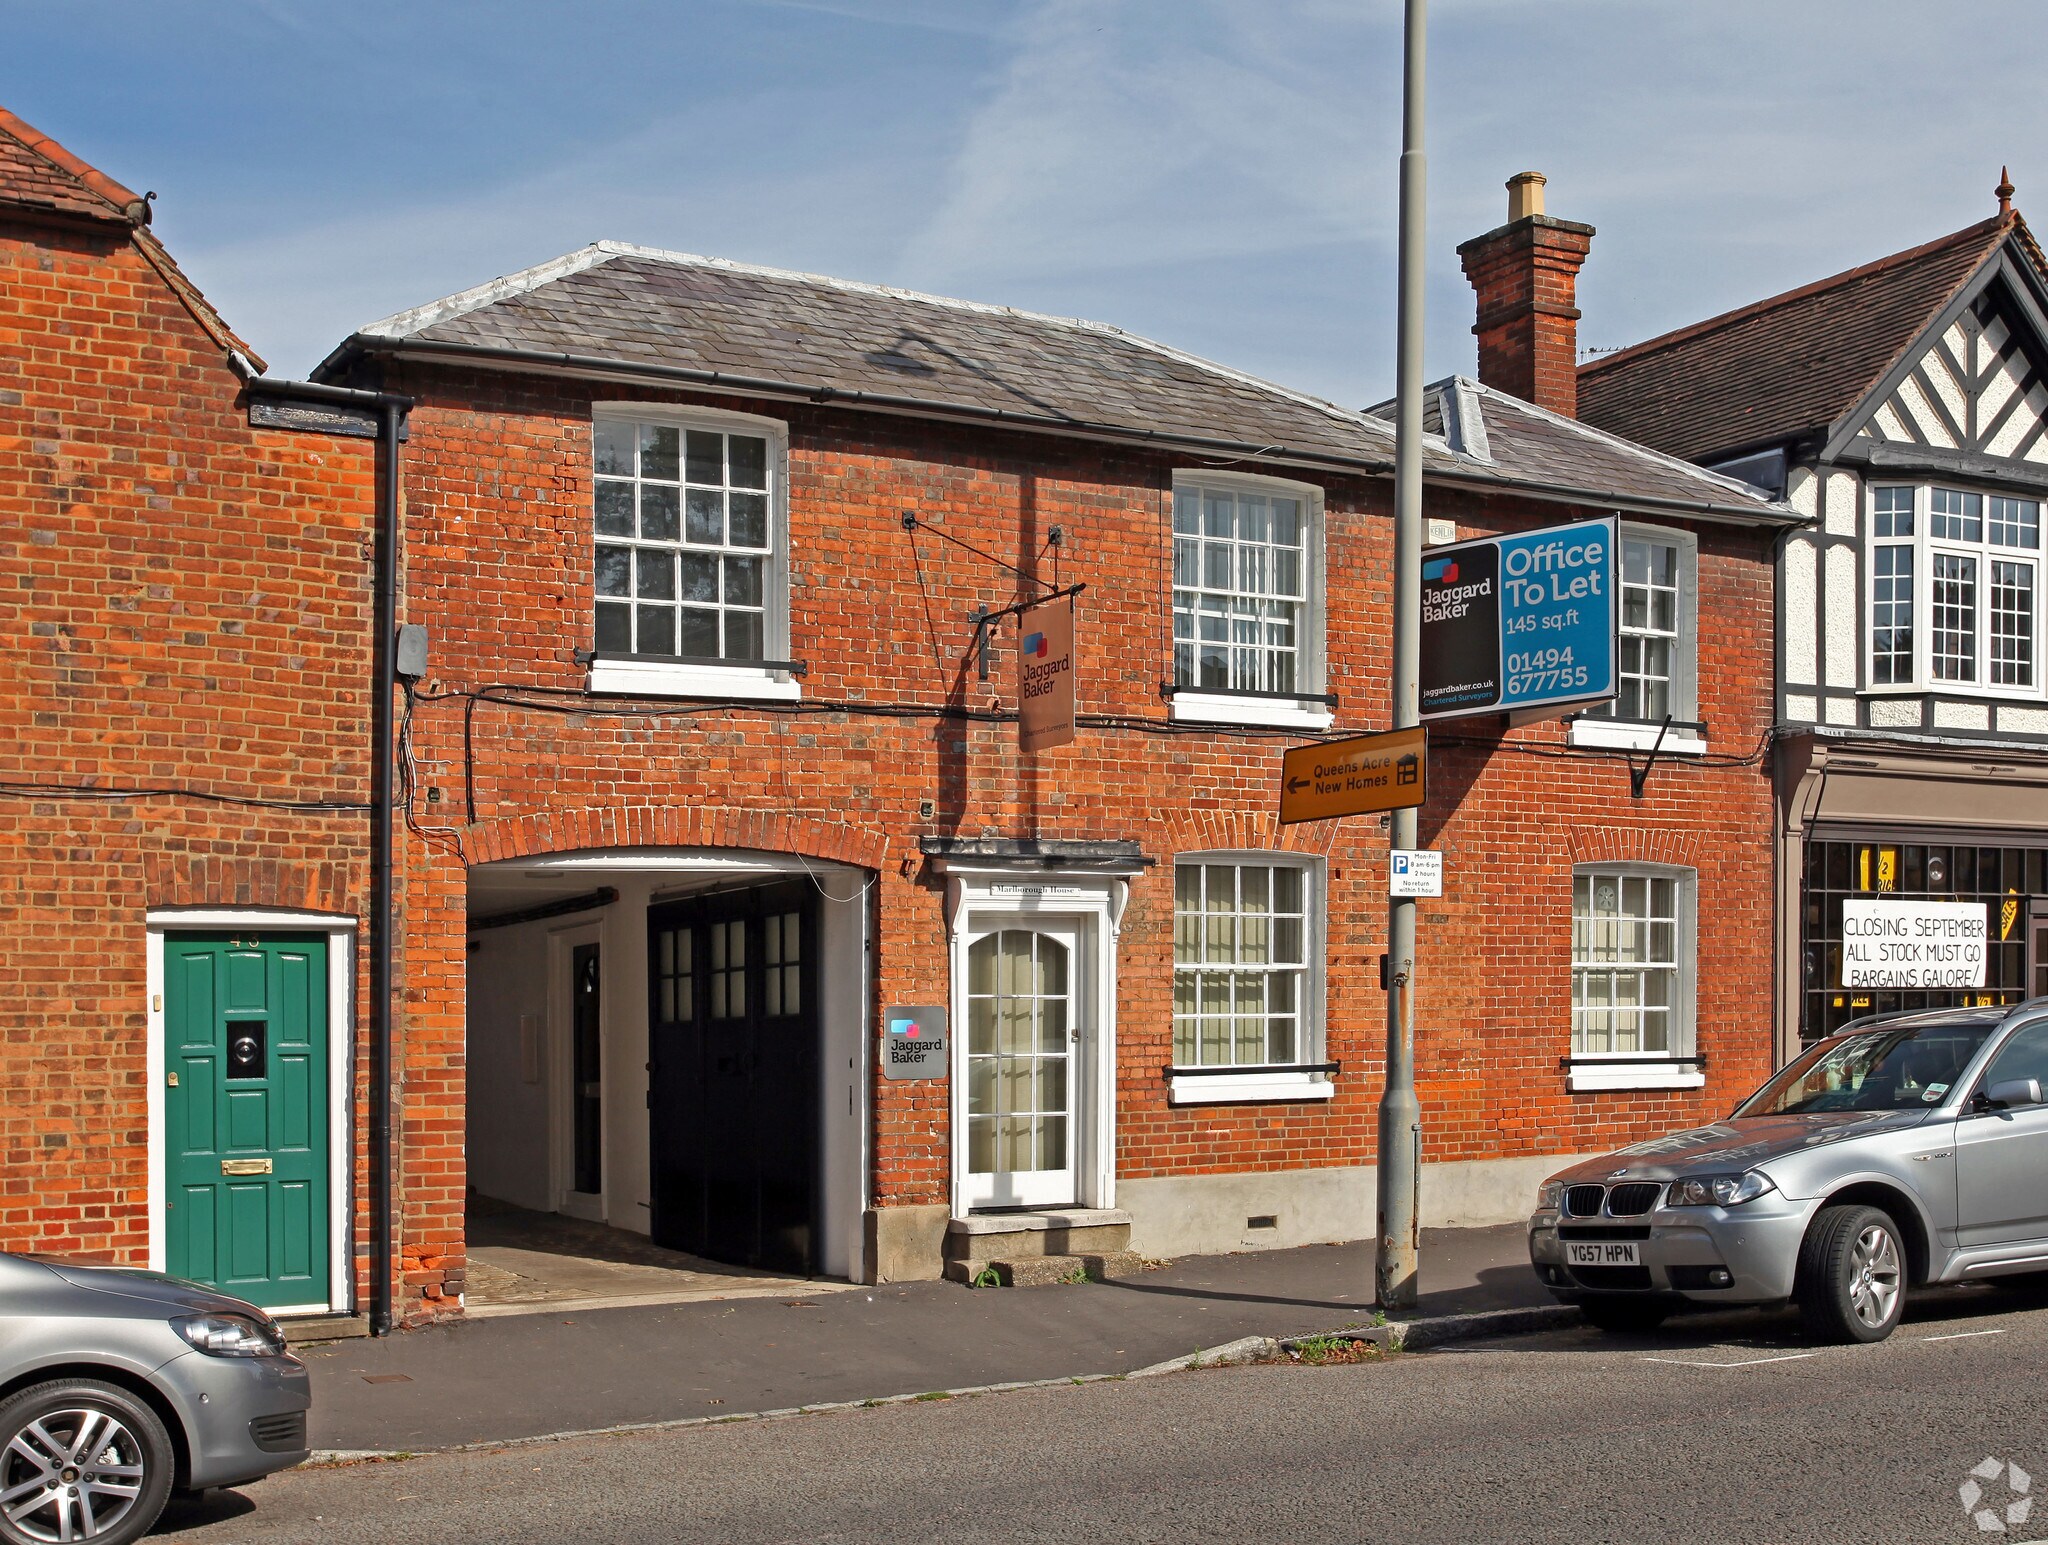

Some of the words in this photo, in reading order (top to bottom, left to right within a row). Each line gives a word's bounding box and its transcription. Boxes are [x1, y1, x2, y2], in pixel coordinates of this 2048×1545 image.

[1505, 541, 1603, 576] Office
[1423, 579, 1491, 606] Jaggard
[1505, 579, 1545, 608] To
[1550, 570, 1601, 601] Let
[1423, 602, 1469, 622] Baker
[1506, 615, 1536, 634] 145
[1542, 609, 1579, 631] sq.ft
[1023, 654, 1069, 682] Jaggard
[1508, 646, 1573, 673] 01494
[1024, 680, 1055, 699] Baker
[1423, 680, 1494, 698] jaggardbaker.co.uk
[1508, 666, 1588, 694] 677755
[1424, 694, 1457, 706] Chartered
[1458, 691, 1493, 702] Surveyors
[1046, 723, 1068, 733] Surveyors
[1314, 762, 1358, 779] Queens
[1362, 757, 1391, 771] Acre
[1315, 781, 1341, 795] New
[1347, 775, 1388, 791] Homes
[996, 885, 1048, 894] Marlborough
[1844, 917, 1908, 936] CLOSING
[1915, 917, 1984, 938] SEPTEMBER
[1846, 943, 1872, 961] ALL
[1879, 943, 1921, 961] STOCK
[1926, 944, 1961, 962] MUST
[1964, 944, 1981, 962] GO
[1851, 968, 1918, 987] BARGAINS
[1923, 964, 1980, 987] GALORE!
[891, 1039, 942, 1053] Jaggard
[891, 1051, 927, 1064] Baker
[1571, 1245, 1601, 1262] YG57
[1605, 1245, 1633, 1262] HPN
